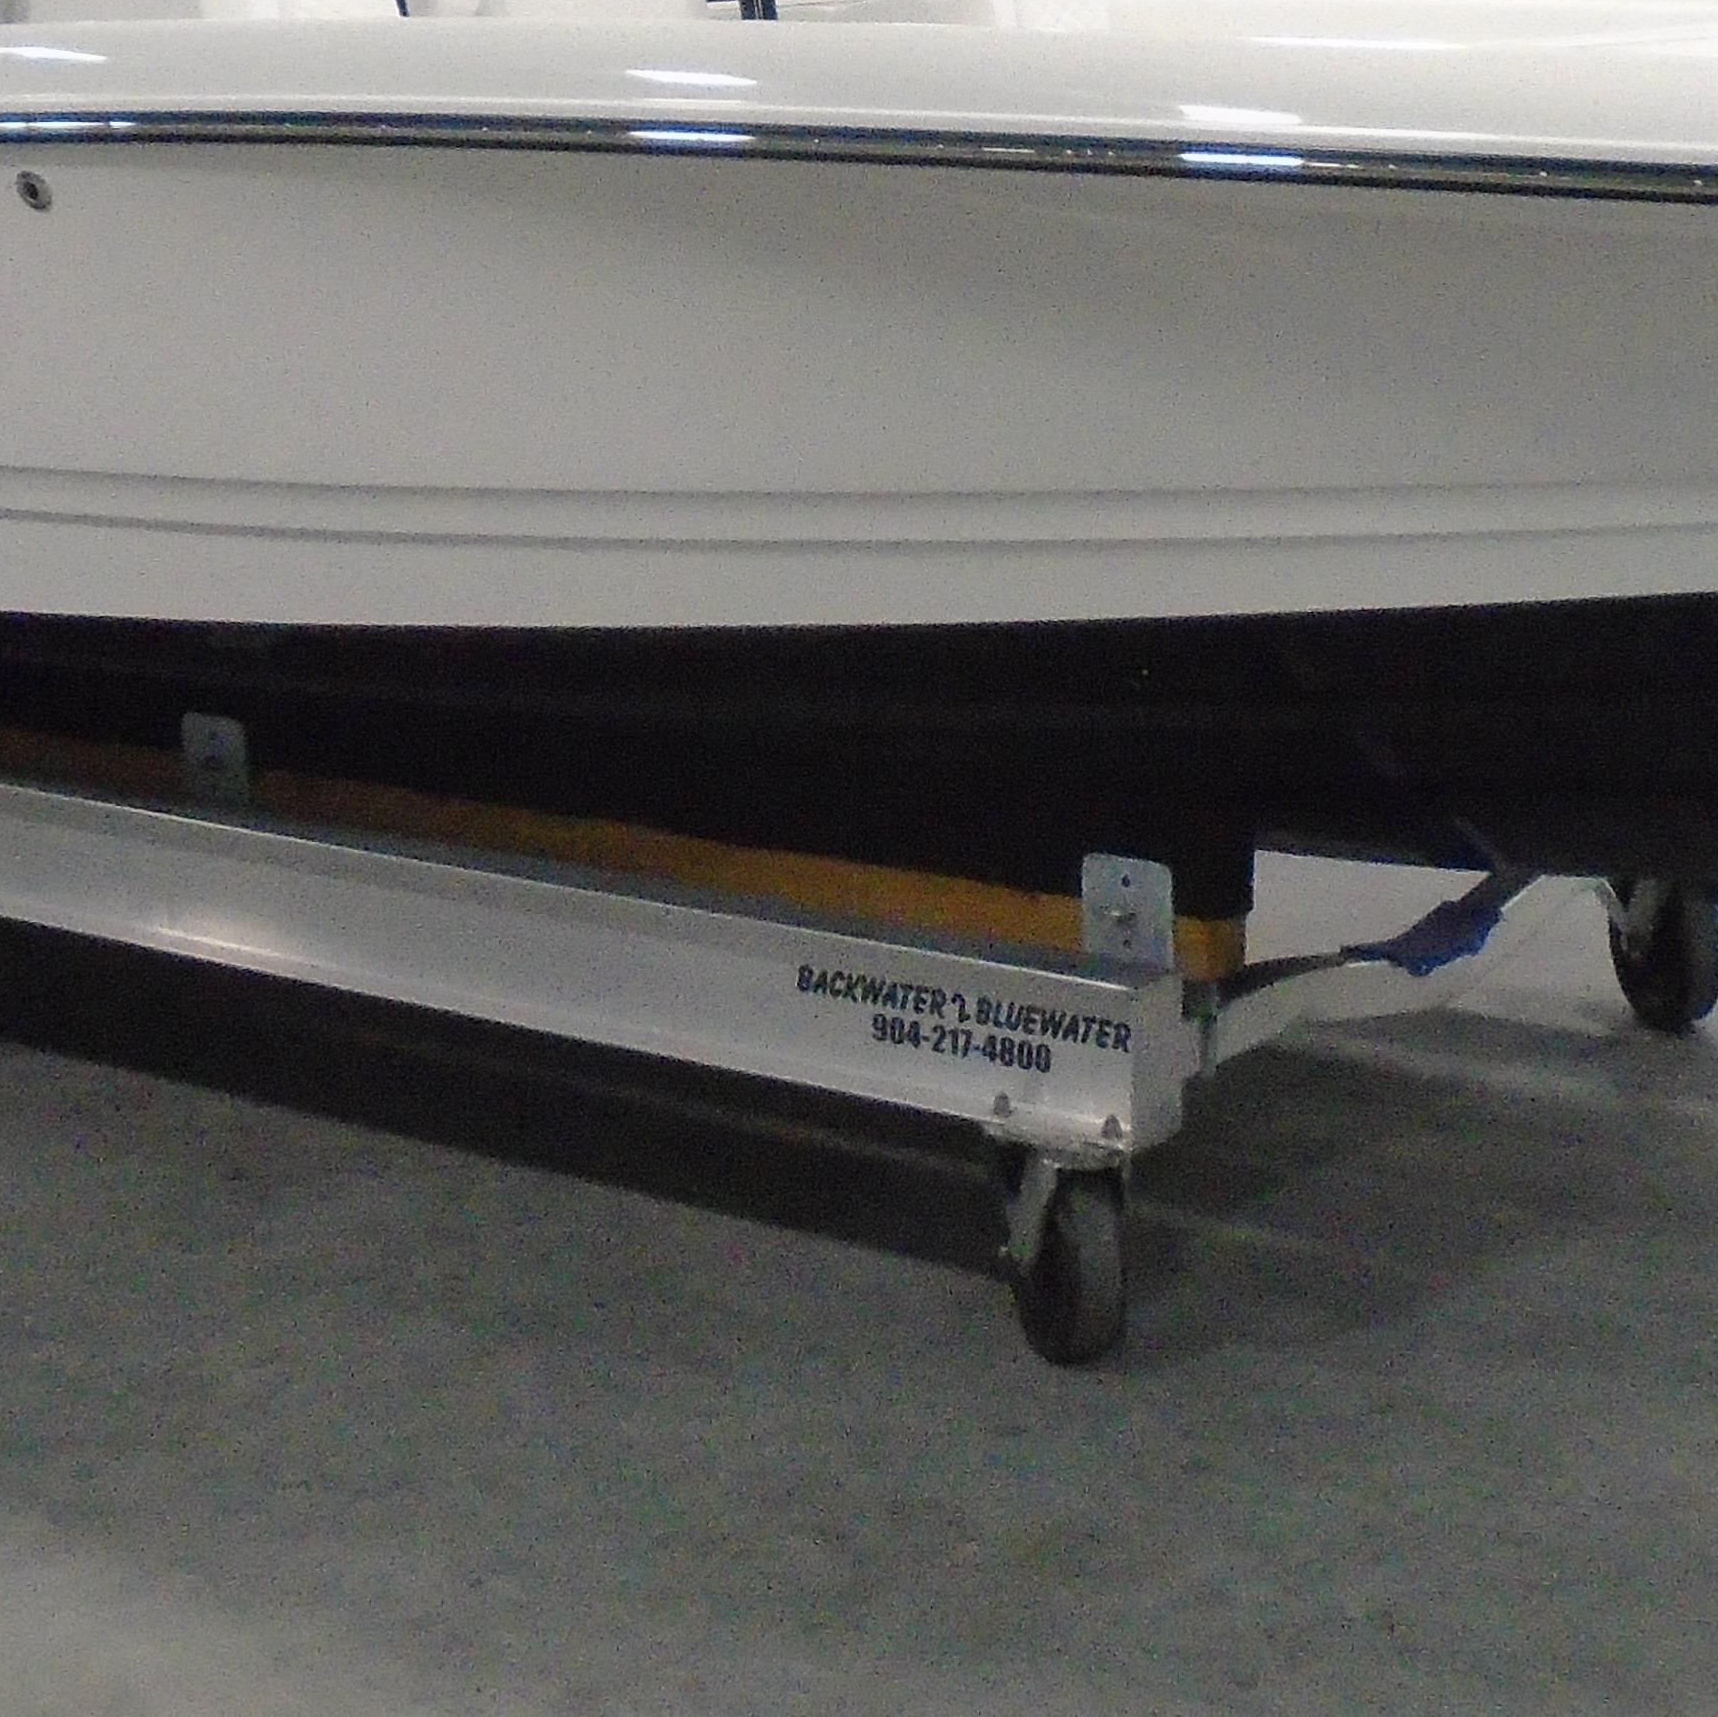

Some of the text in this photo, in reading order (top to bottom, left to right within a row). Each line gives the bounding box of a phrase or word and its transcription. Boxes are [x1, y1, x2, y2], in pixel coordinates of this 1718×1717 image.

[795, 963, 947, 1020] BACKWATER
[975, 994, 1133, 1054] BLUEWATER
[871, 1013, 1052, 1074] 904-217-4800
